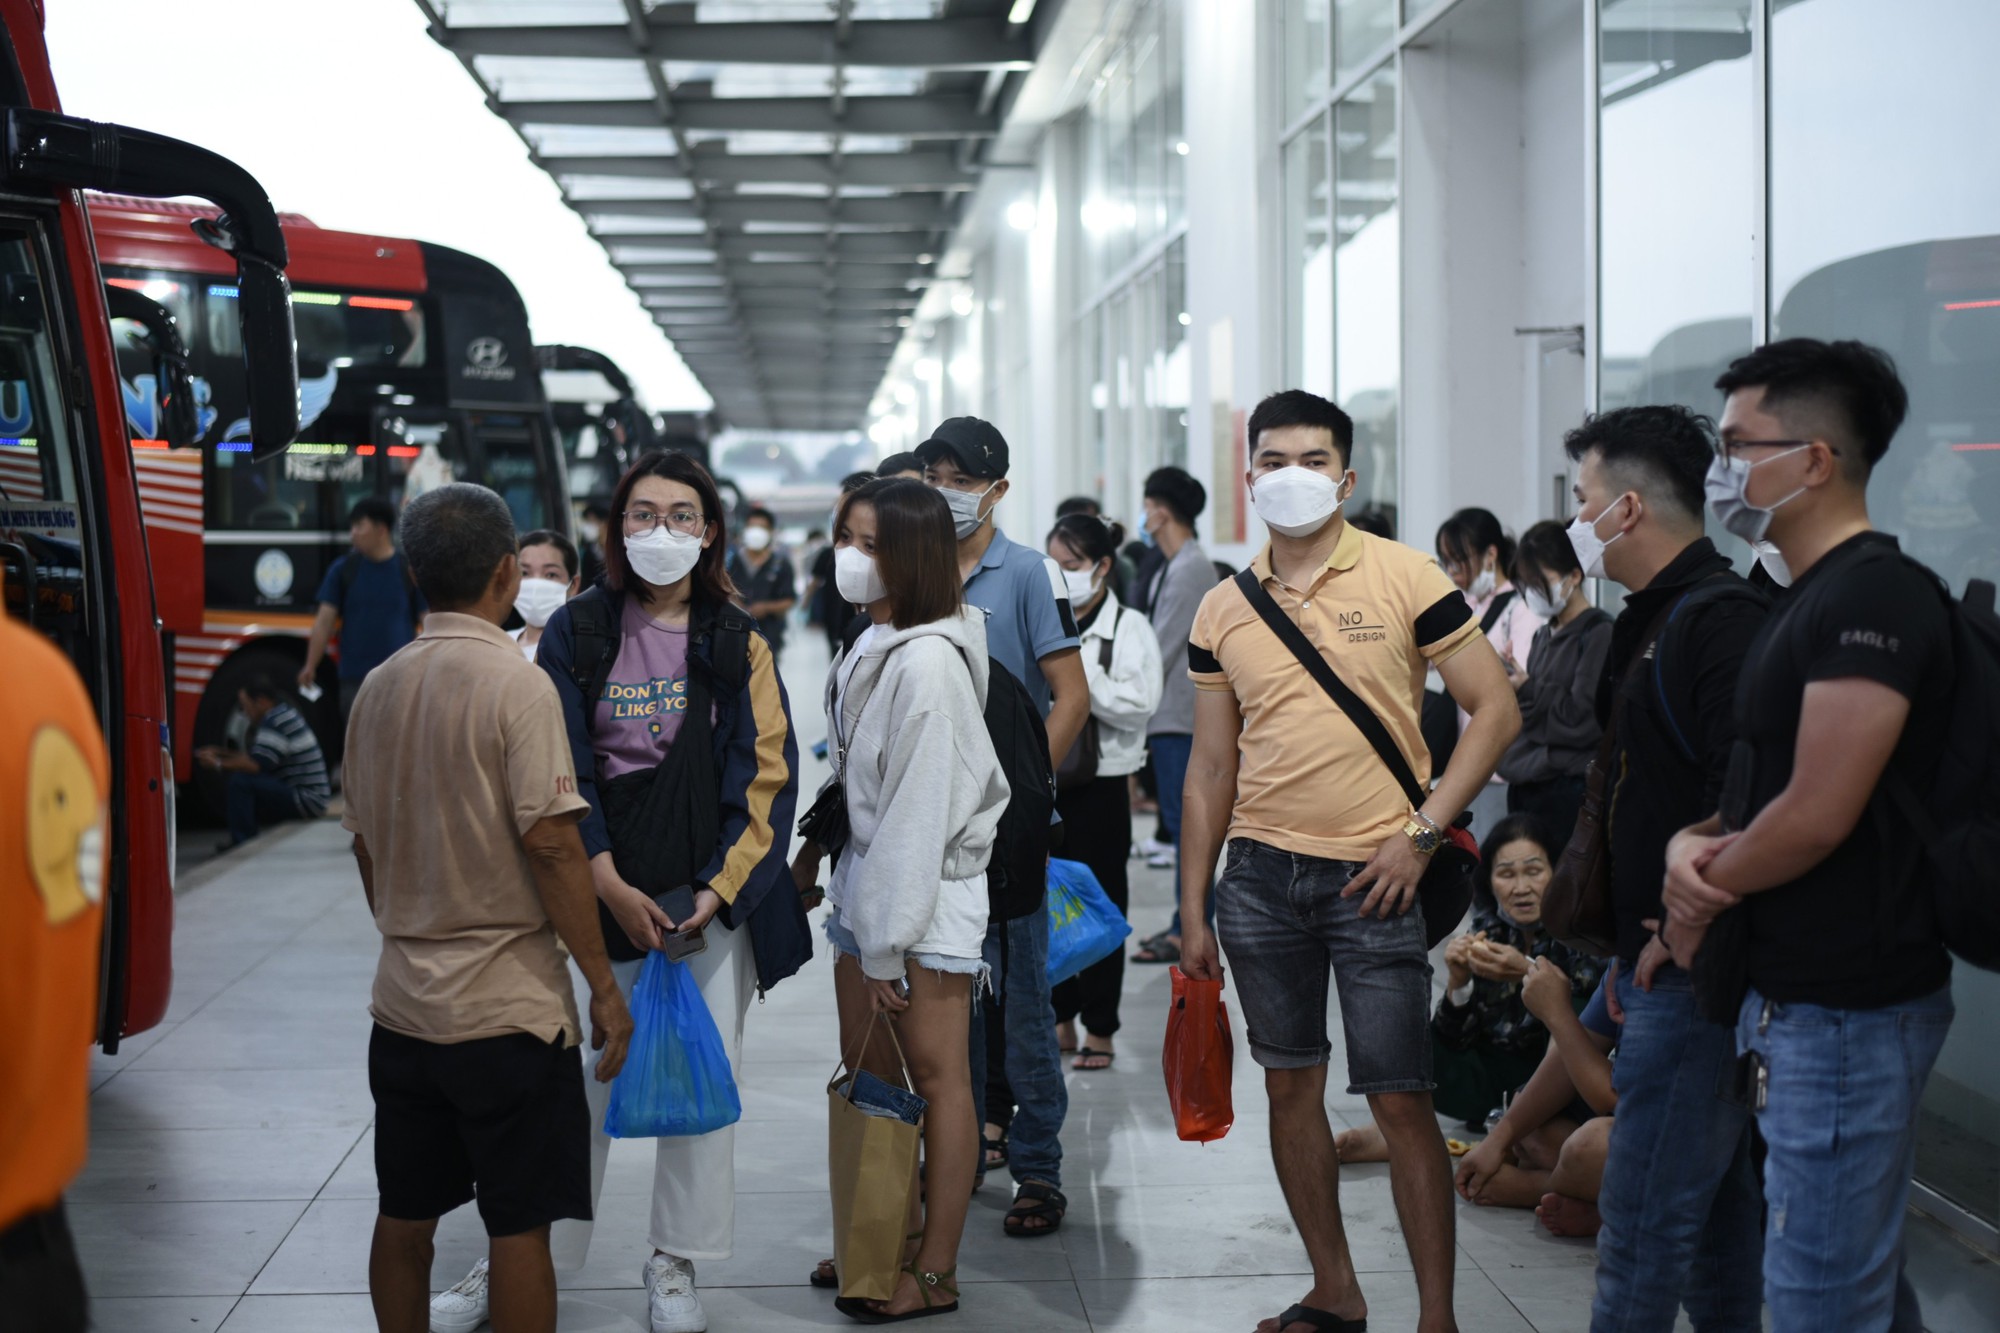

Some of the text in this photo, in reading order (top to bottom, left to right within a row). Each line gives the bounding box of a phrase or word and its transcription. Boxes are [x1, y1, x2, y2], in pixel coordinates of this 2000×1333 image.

[1339, 611, 1362, 627] NO
[1348, 632, 1385, 643] DESIGN
[615, 701, 657, 717] LIKE
